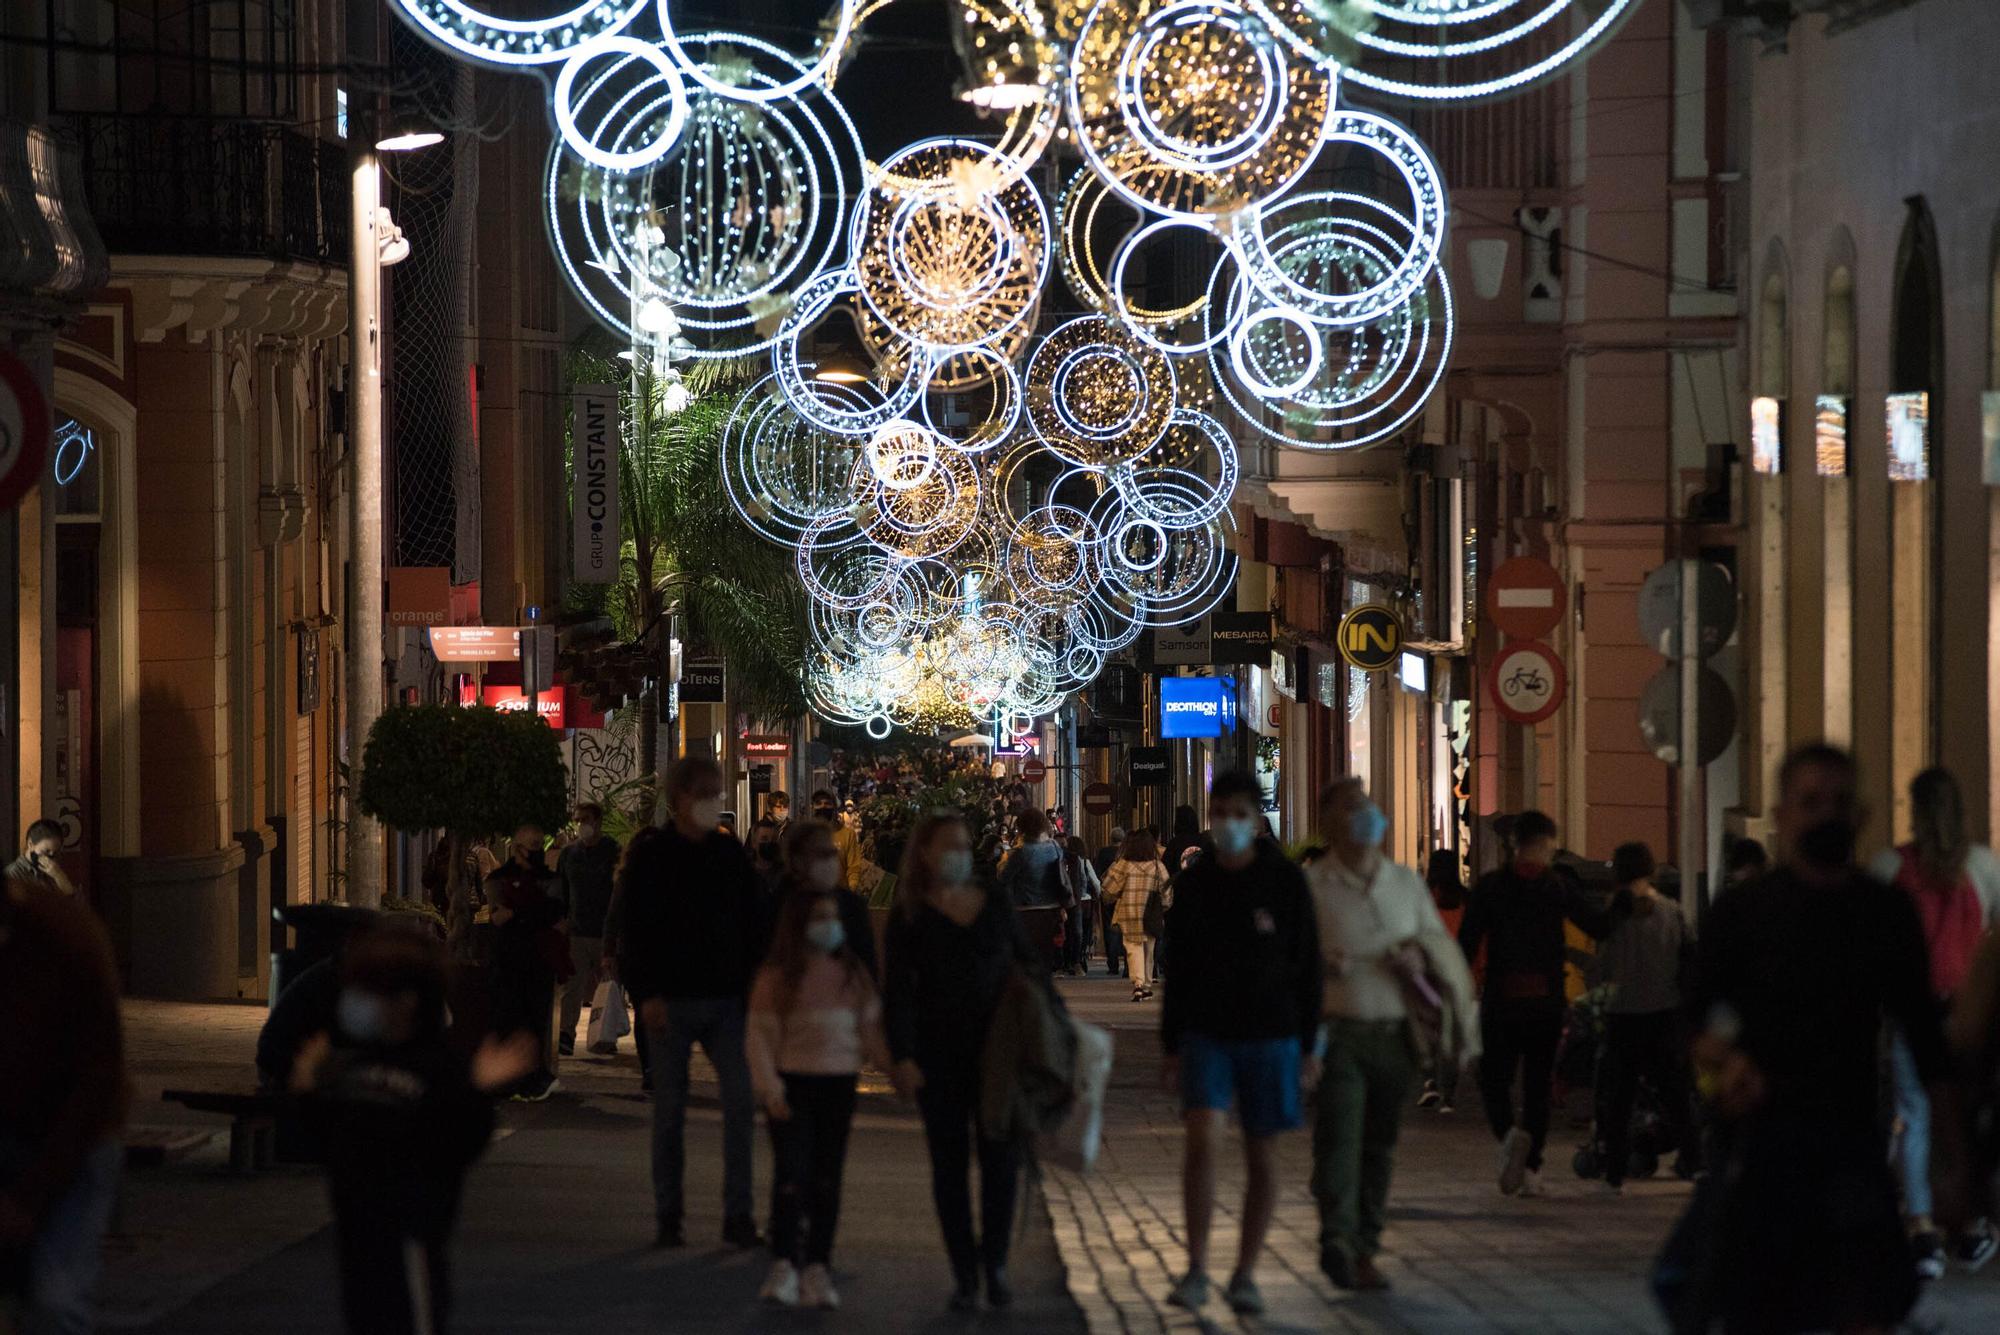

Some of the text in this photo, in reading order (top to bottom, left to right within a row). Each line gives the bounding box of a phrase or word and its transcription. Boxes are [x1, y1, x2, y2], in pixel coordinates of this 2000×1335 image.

[587, 399, 606, 521] CONSTANT
[392, 610, 444, 624] orange
[1213, 631, 1269, 639] MESAIRA
[1349, 623, 1396, 653] IN
[495, 698, 561, 712] SPOIUM
[1166, 702, 1217, 712] DECATHLON
